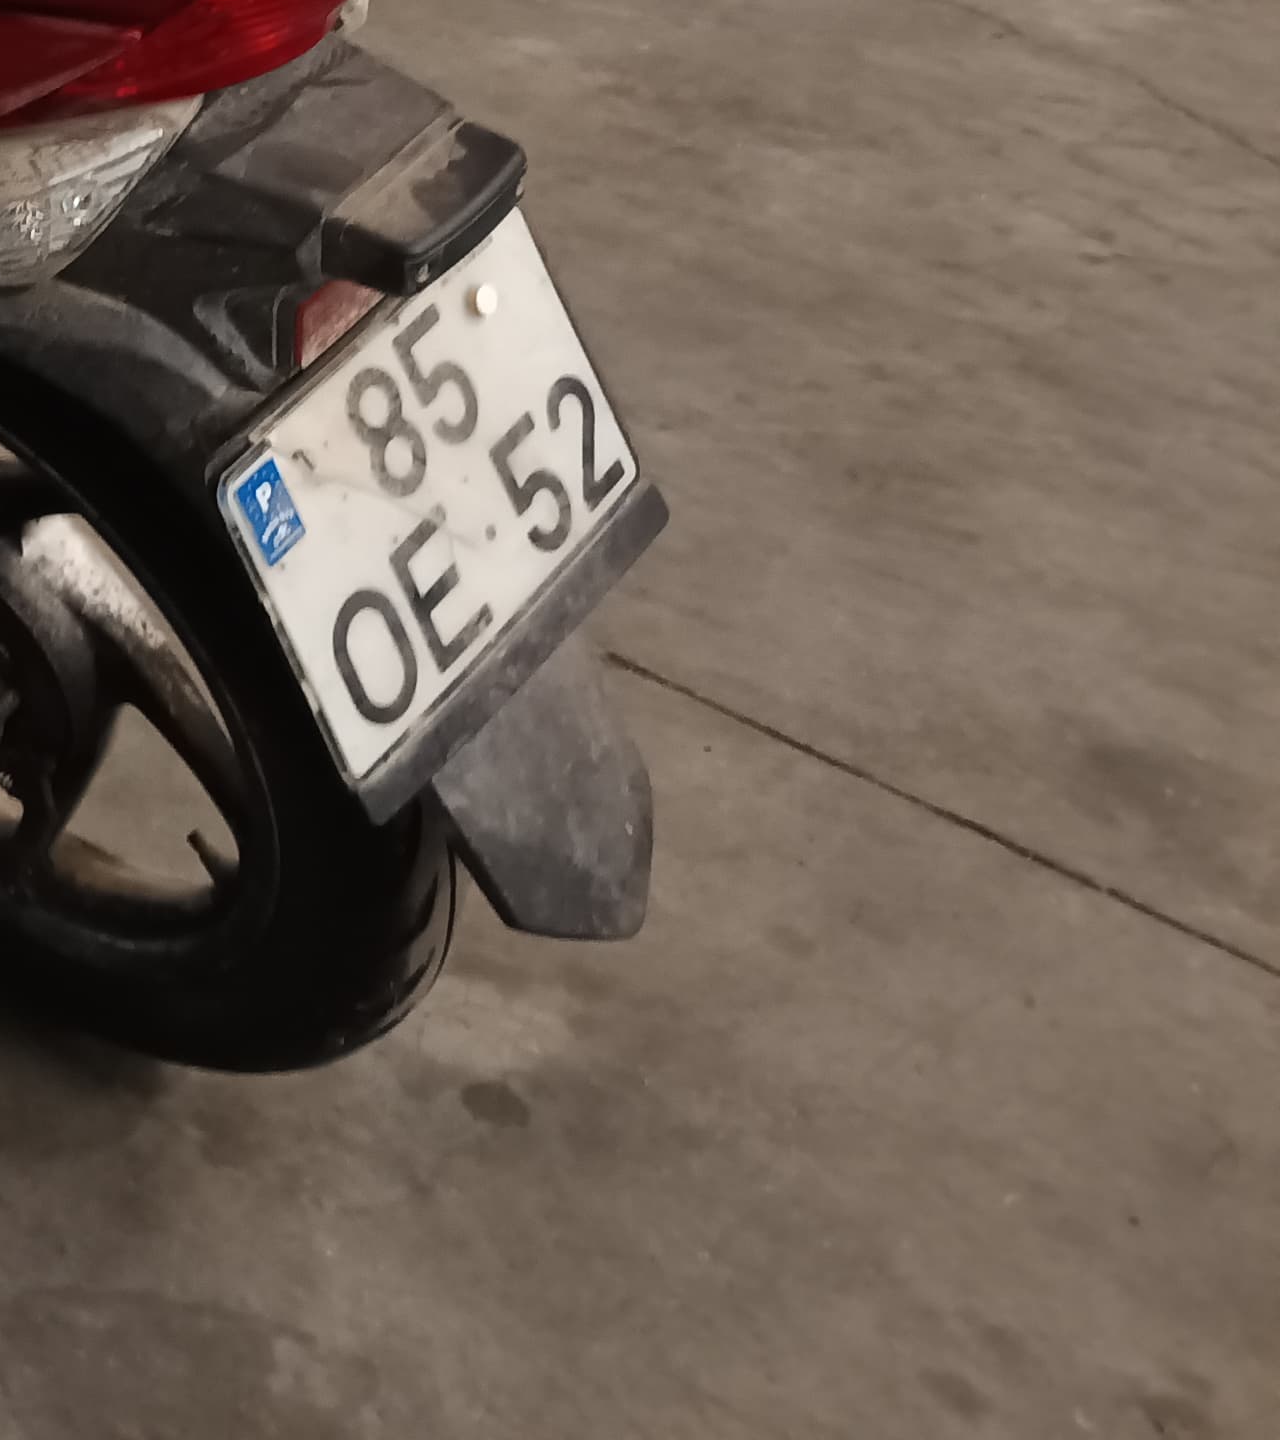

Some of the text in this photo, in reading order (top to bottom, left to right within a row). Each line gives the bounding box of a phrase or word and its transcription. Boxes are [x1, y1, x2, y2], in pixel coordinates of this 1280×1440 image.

[345, 303, 479, 497] 85
[490, 376, 626, 551] 52
[255, 481, 272, 513] P
